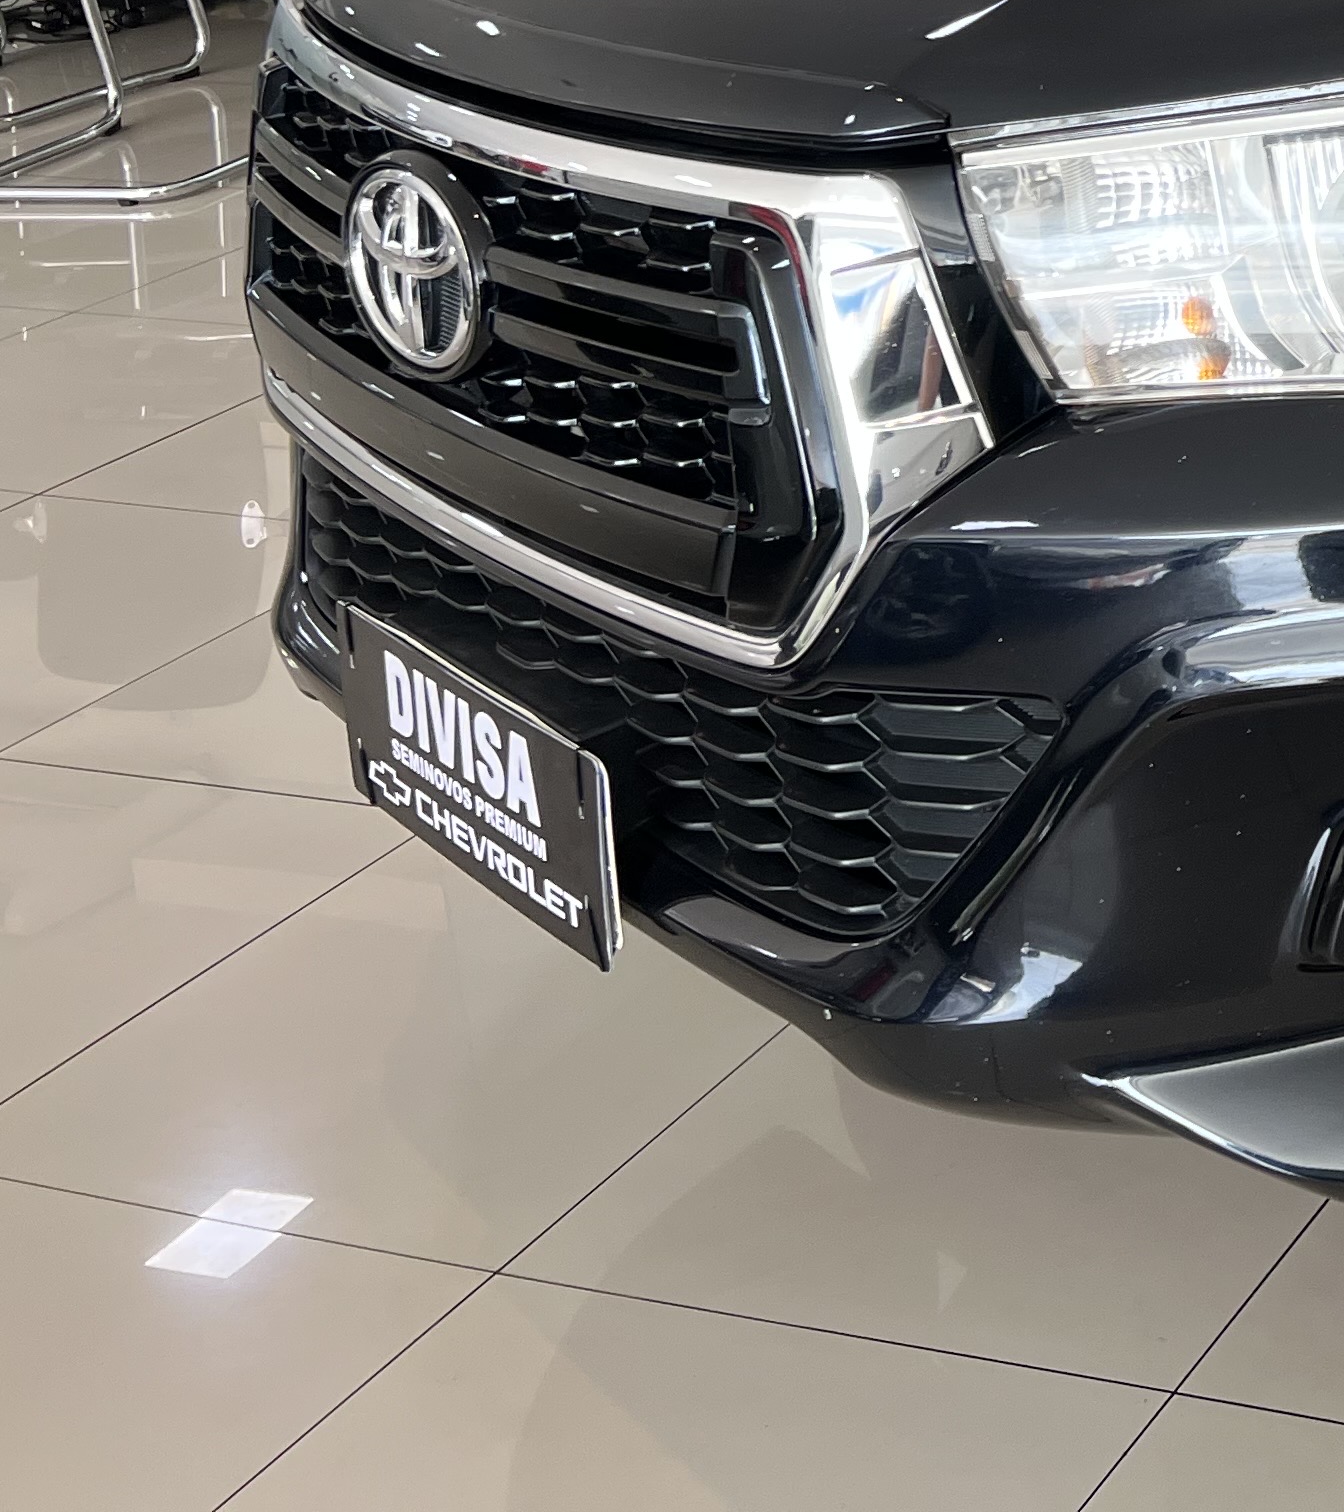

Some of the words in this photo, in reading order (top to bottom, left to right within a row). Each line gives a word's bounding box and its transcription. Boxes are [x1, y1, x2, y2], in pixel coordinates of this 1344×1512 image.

[384, 649, 542, 828] DIVISA
[391, 738, 473, 810] SEMINOVOS
[474, 795, 548, 862] PREMIUM
[414, 788, 583, 929] CHEVROLET
